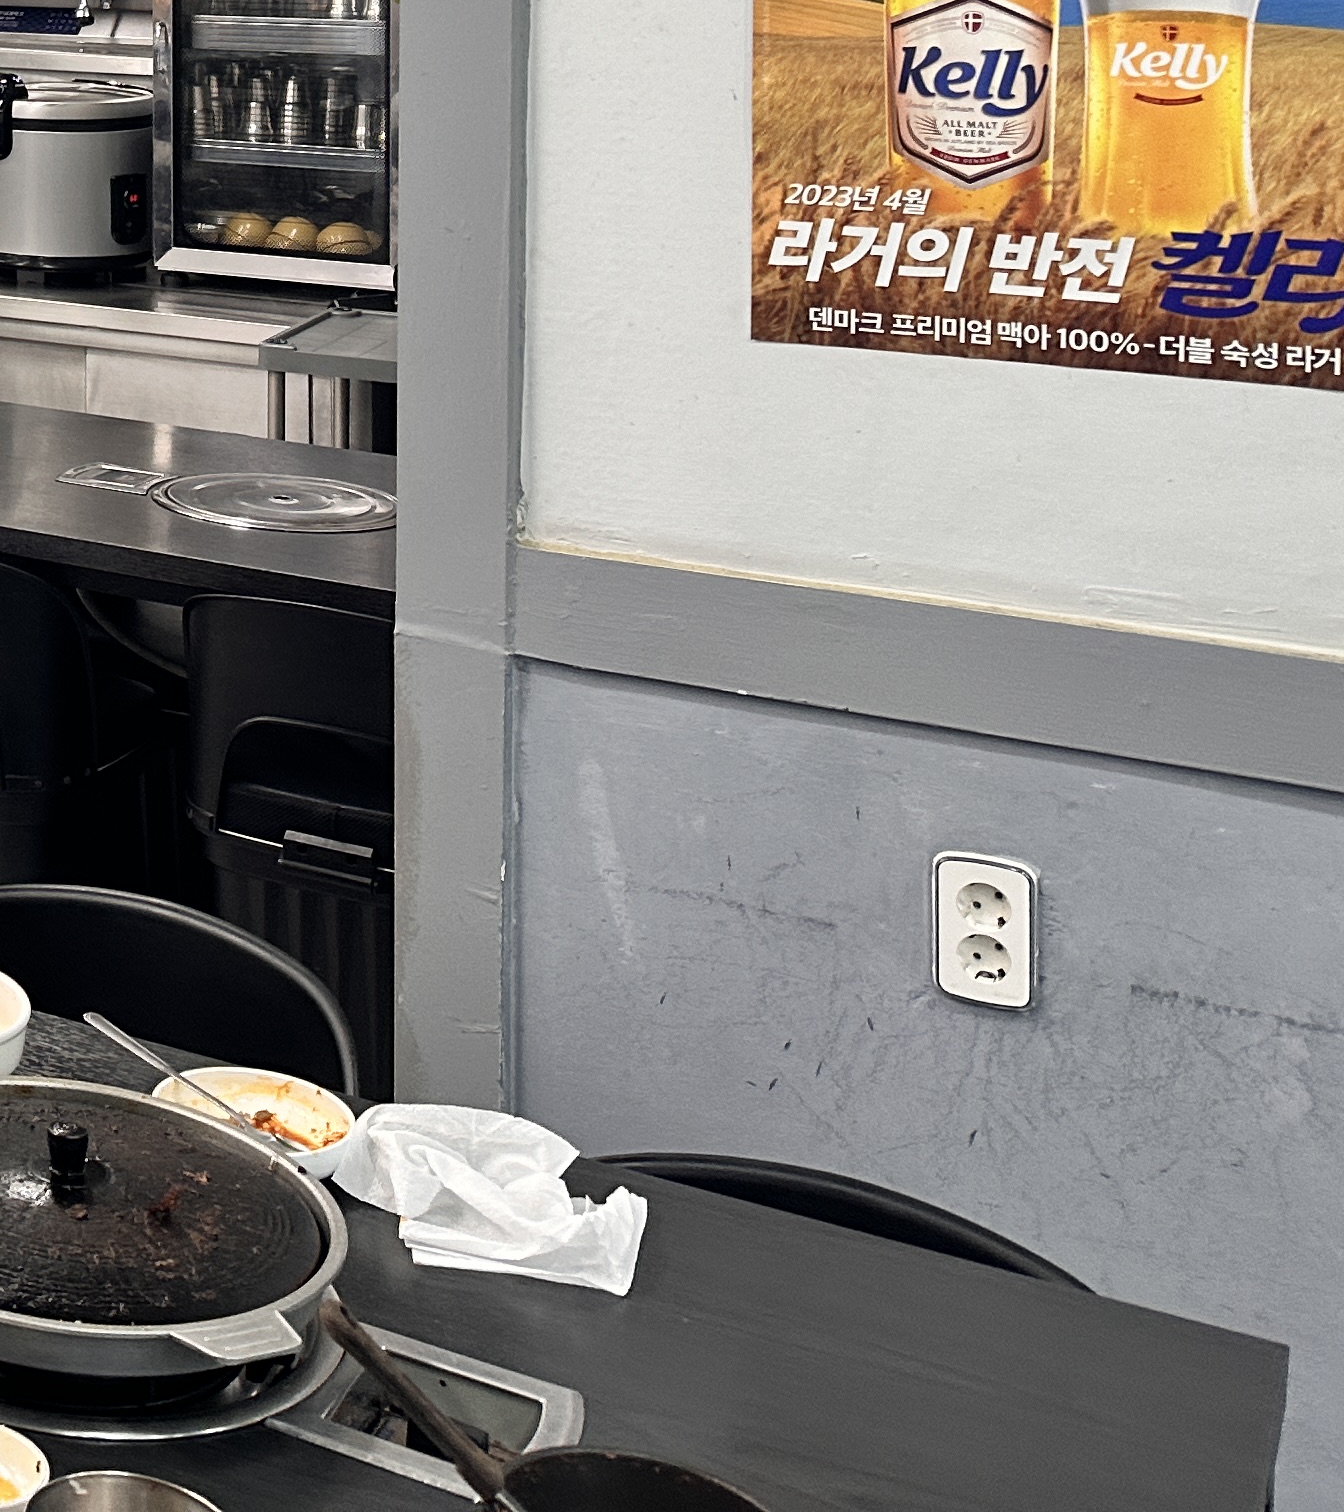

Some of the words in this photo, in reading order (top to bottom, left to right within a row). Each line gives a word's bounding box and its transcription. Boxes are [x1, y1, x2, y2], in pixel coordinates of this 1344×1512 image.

[898, 46, 1049, 117] Kelly
[1110, 41, 1228, 90] Kelly
[942, 120, 963, 128] ALL
[967, 120, 998, 129] MALT
[954, 129, 986, 137] BEER
[784, 183, 879, 211] 2023년
[883, 188, 931, 216] 4월
[768, 218, 975, 293] 라거의
[988, 230, 1136, 304] 반전
[808, 307, 884, 335] 덴마크
[890, 313, 992, 346] 프리미엄
[997, 322, 1051, 350] 맥아
[1220, 341, 1279, 369] 숙성
[1286, 345, 1343, 376] 라거
